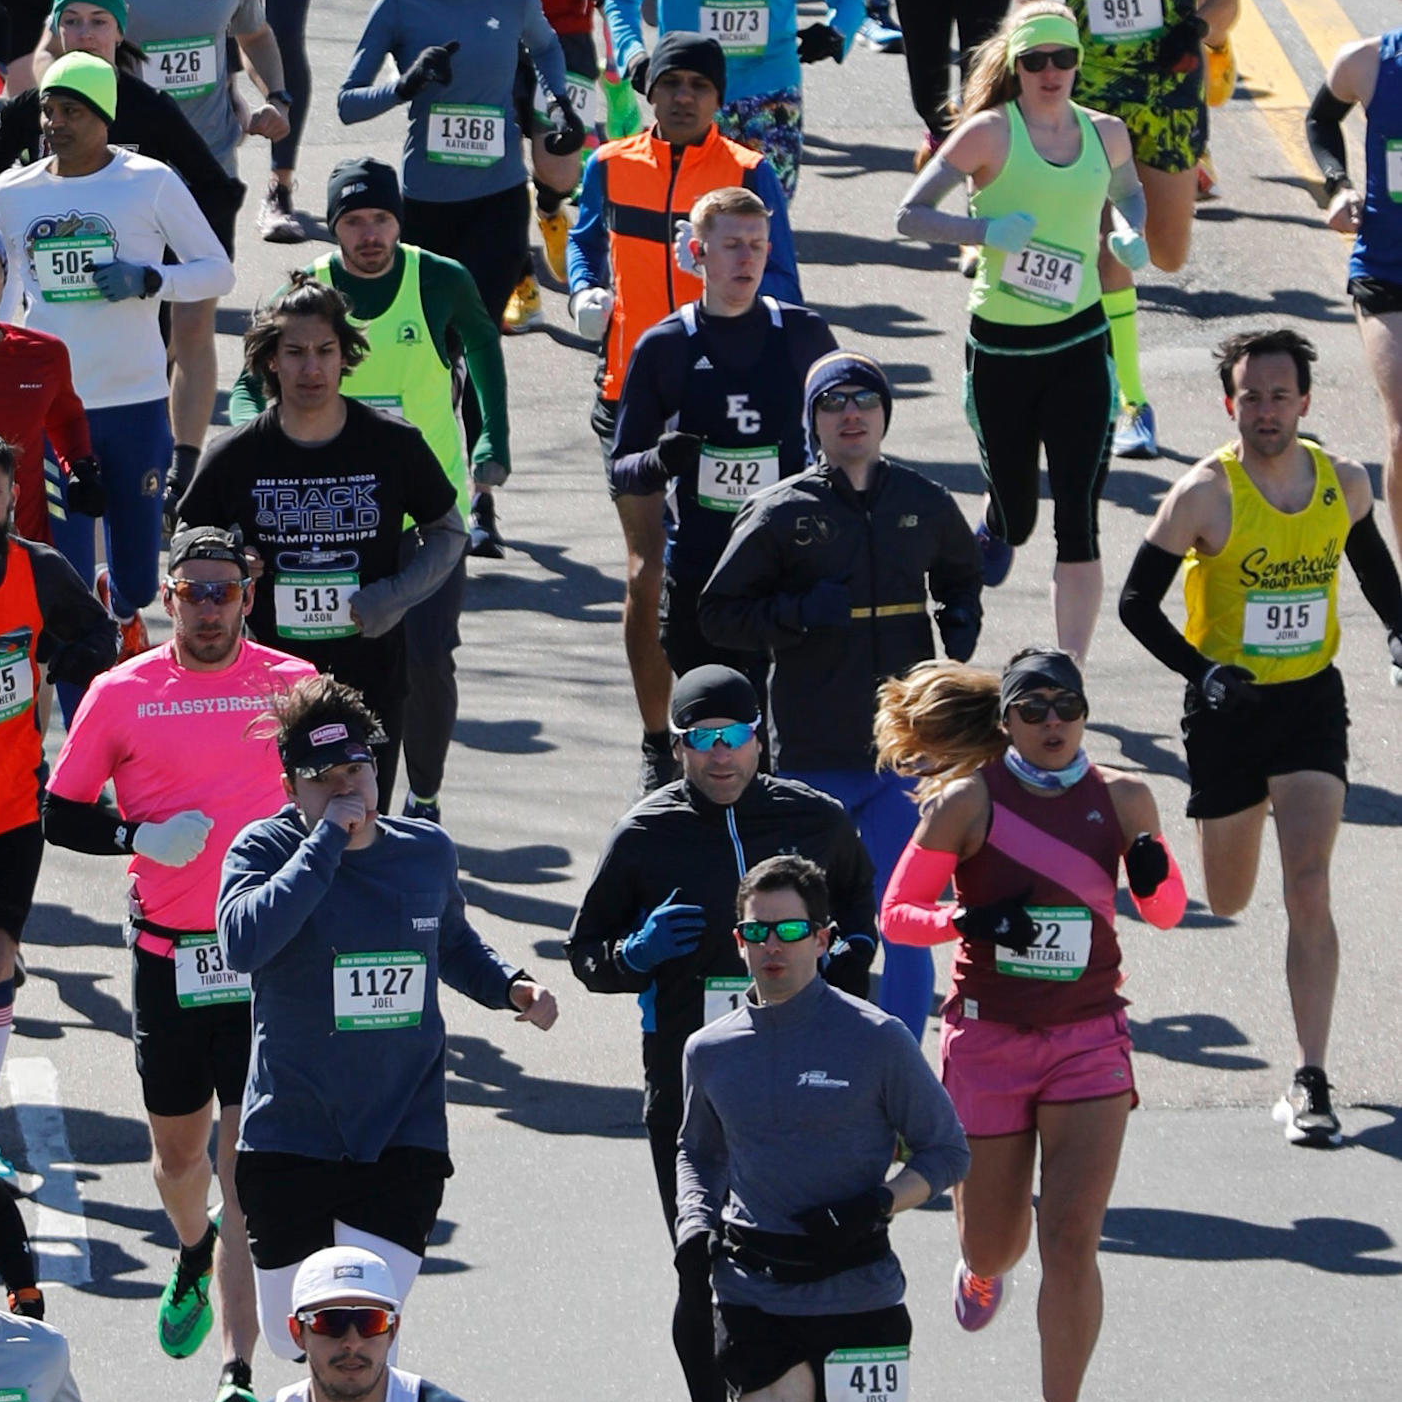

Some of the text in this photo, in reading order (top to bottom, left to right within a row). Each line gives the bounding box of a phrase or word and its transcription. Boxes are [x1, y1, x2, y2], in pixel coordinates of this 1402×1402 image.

[709, 10, 760, 33] 1073
[1102, 0, 1143, 20] 991
[159, 52, 201, 79] 426
[440, 117, 495, 142] 1368
[50, 249, 94, 276] 505
[1017, 249, 1075, 284] 1394
[277, 479, 300, 488] NCAA
[302, 476, 337, 487] DIVISION
[347, 474, 377, 485] INDOOR
[714, 462, 761, 487] 242
[251, 484, 380, 512] TRACK
[258, 529, 377, 544] CHAMPIONSHIPS
[1260, 576, 1290, 590] ROAD
[293, 587, 340, 613] 513
[302, 611, 333, 623] JASON
[1264, 604, 1310, 630] 915
[193, 947, 225, 975] 83
[199, 973, 239, 990] TIMOTHY
[348, 968, 414, 998] 1127
[370, 997, 395, 1009] JOEL
[848, 1363, 899, 1394] 419
